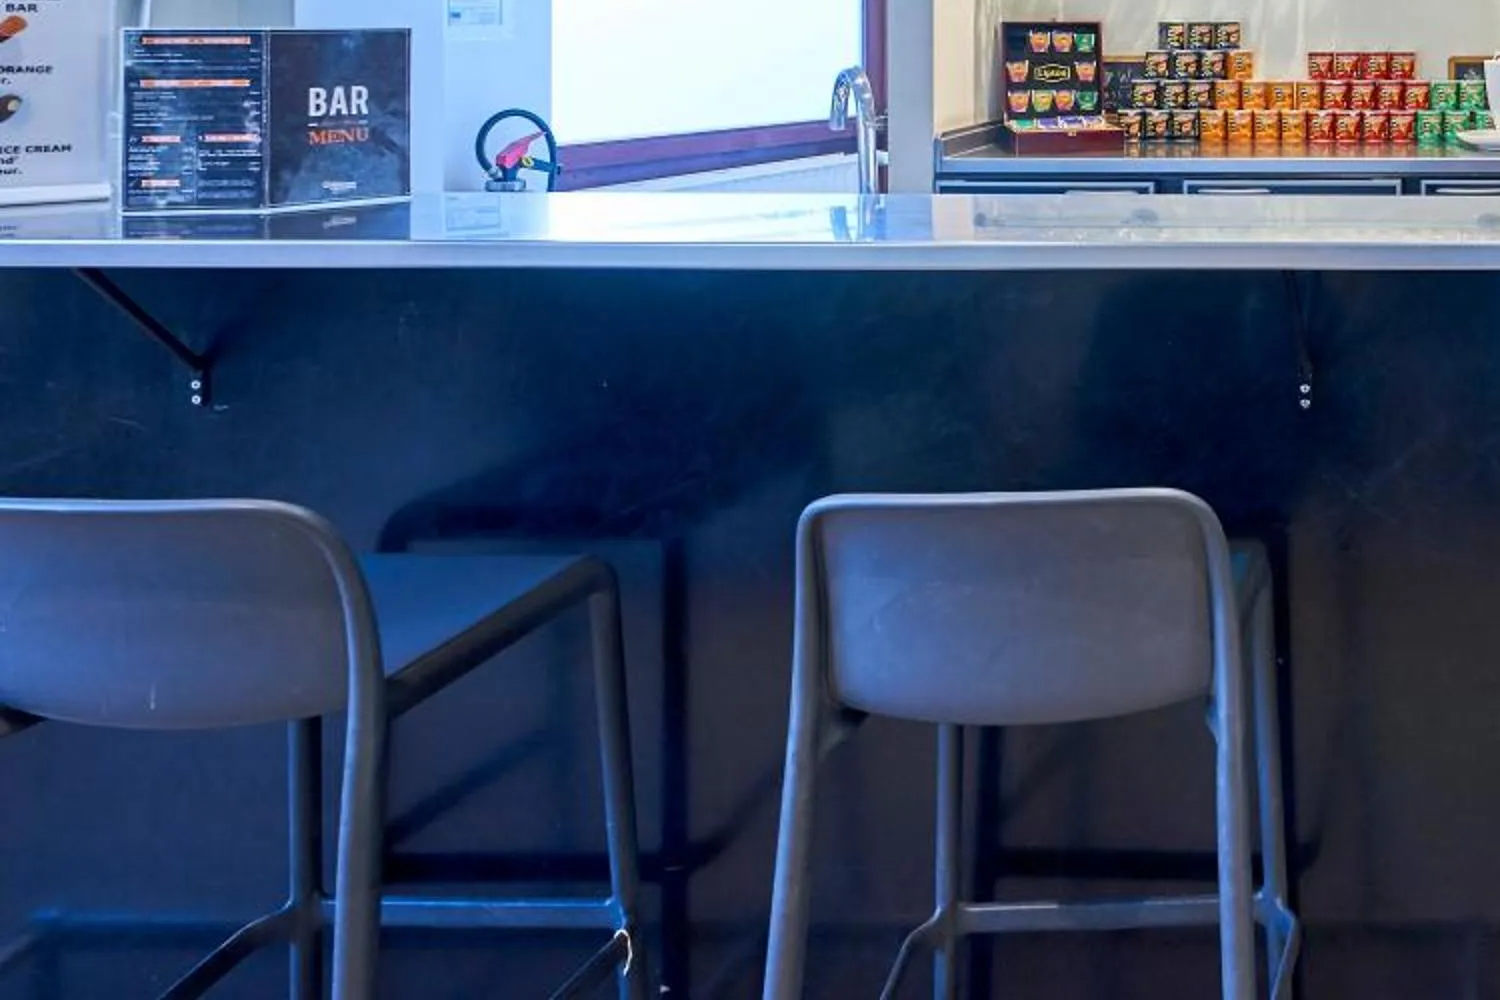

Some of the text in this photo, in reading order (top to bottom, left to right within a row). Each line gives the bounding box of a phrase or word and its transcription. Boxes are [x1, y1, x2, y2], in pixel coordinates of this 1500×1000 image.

[5, 3, 39, 13] BAR
[308, 85, 369, 117] BAR
[308, 127, 369, 145] MENU
[25, 144, 72, 153] CREAM
